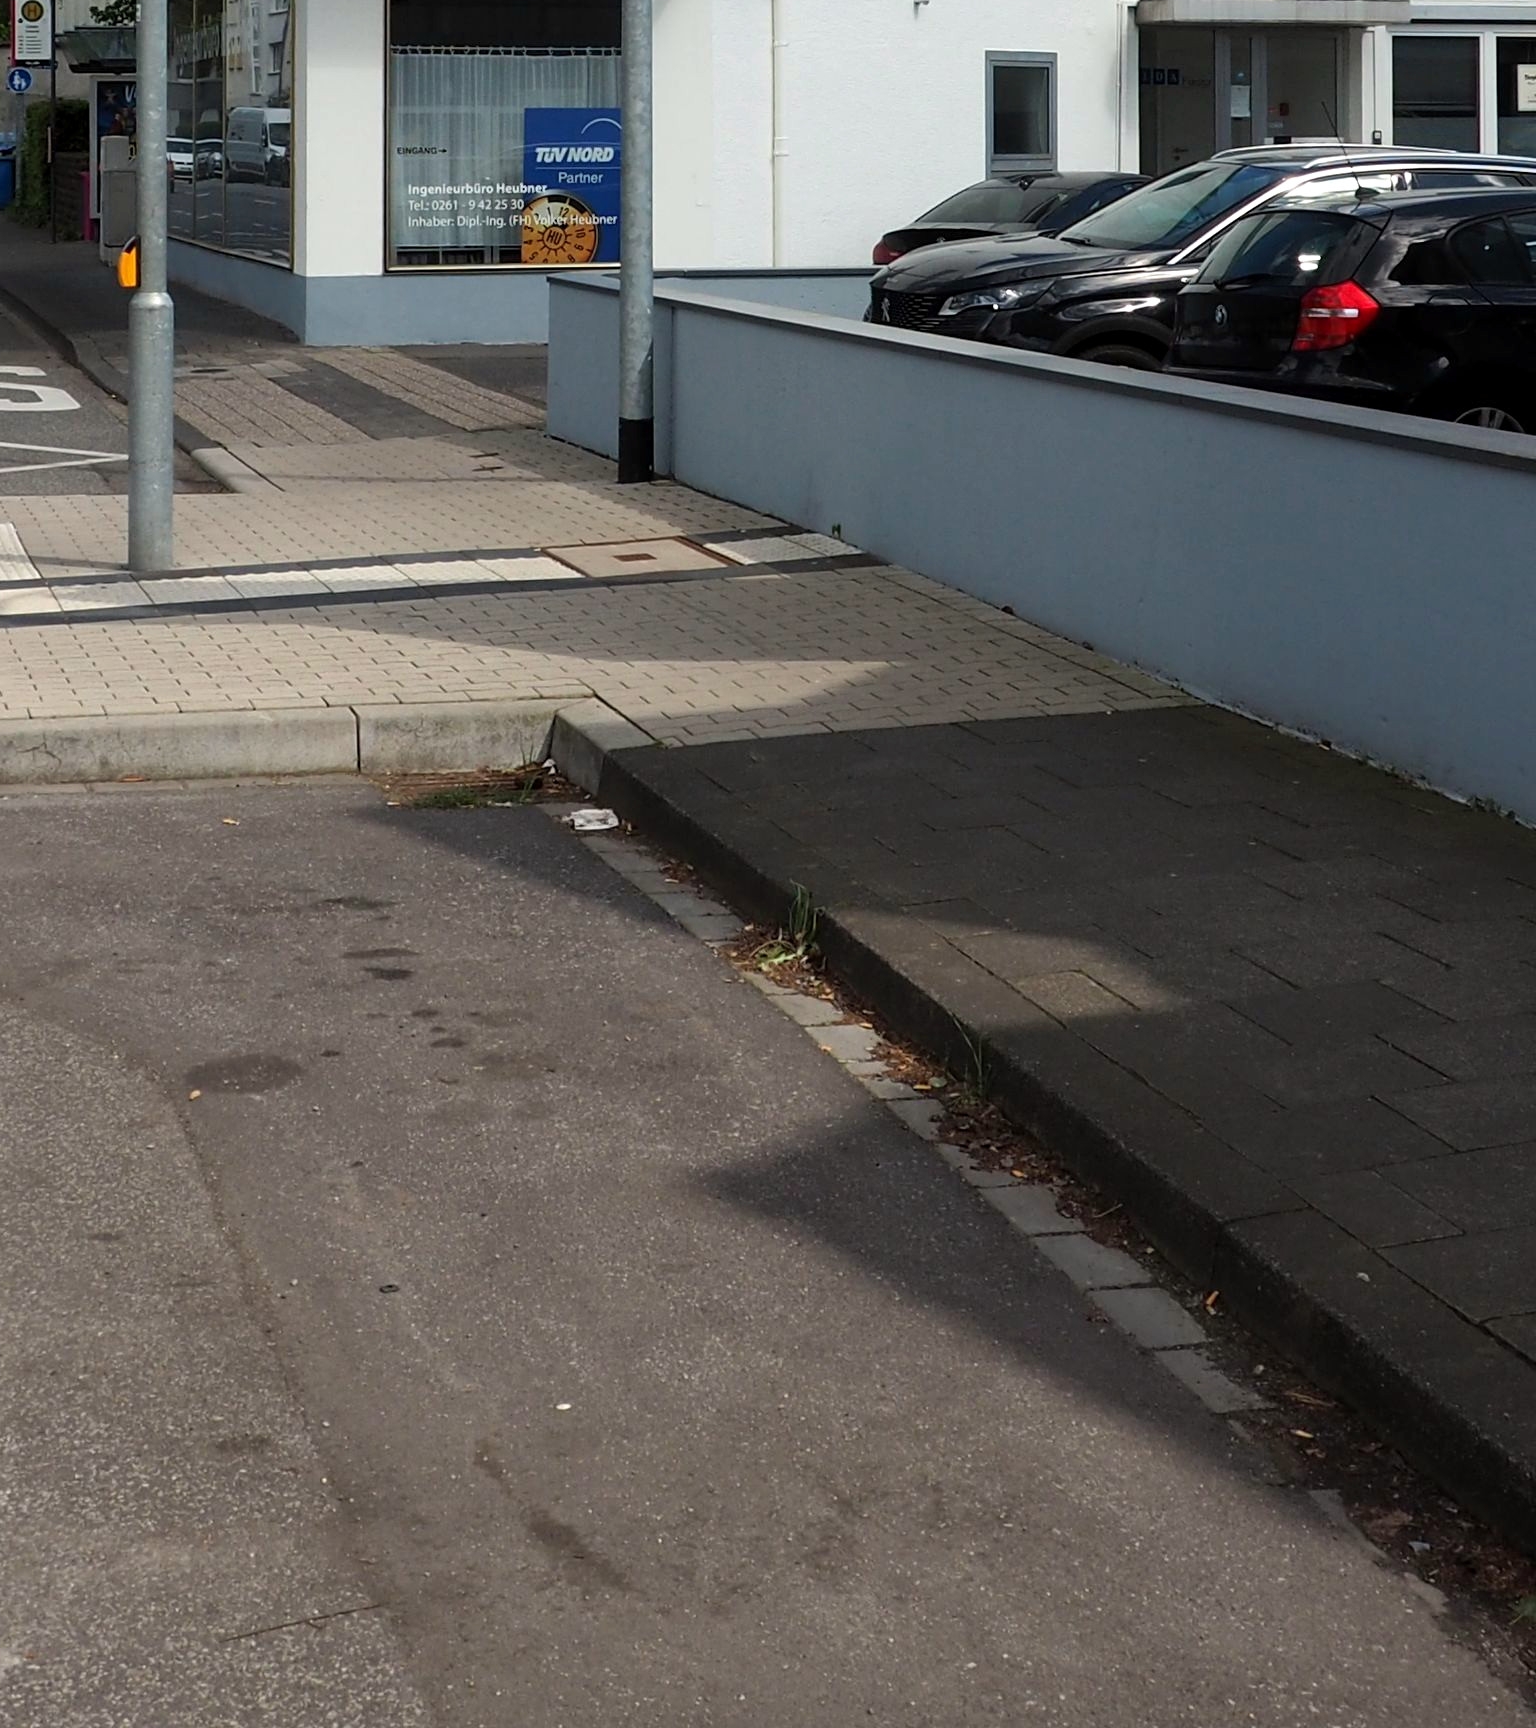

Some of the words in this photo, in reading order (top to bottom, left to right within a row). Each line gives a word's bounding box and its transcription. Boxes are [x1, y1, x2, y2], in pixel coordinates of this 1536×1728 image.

[536, 147, 568, 163] TÜV
[569, 147, 614, 162] NORD
[558, 172, 603, 184] Partner
[408, 183, 493, 196] Ingenieurbüro
[496, 183, 547, 194] Heubner
[409, 200, 429, 211] Tel.:
[431, 200, 458, 210] 0261
[469, 199, 476, 210] 9
[477, 199, 492, 210] 42
[495, 199, 508, 209] 25
[511, 199, 525, 209] 30
[408, 216, 454, 227] Inhaber:
[457, 215, 506, 228] Dipl.-Ing.
[509, 215, 531, 227] (FH)
[533, 215, 567, 226] Volker
[571, 214, 618, 225] Heubner
[546, 229, 562, 246] HU
